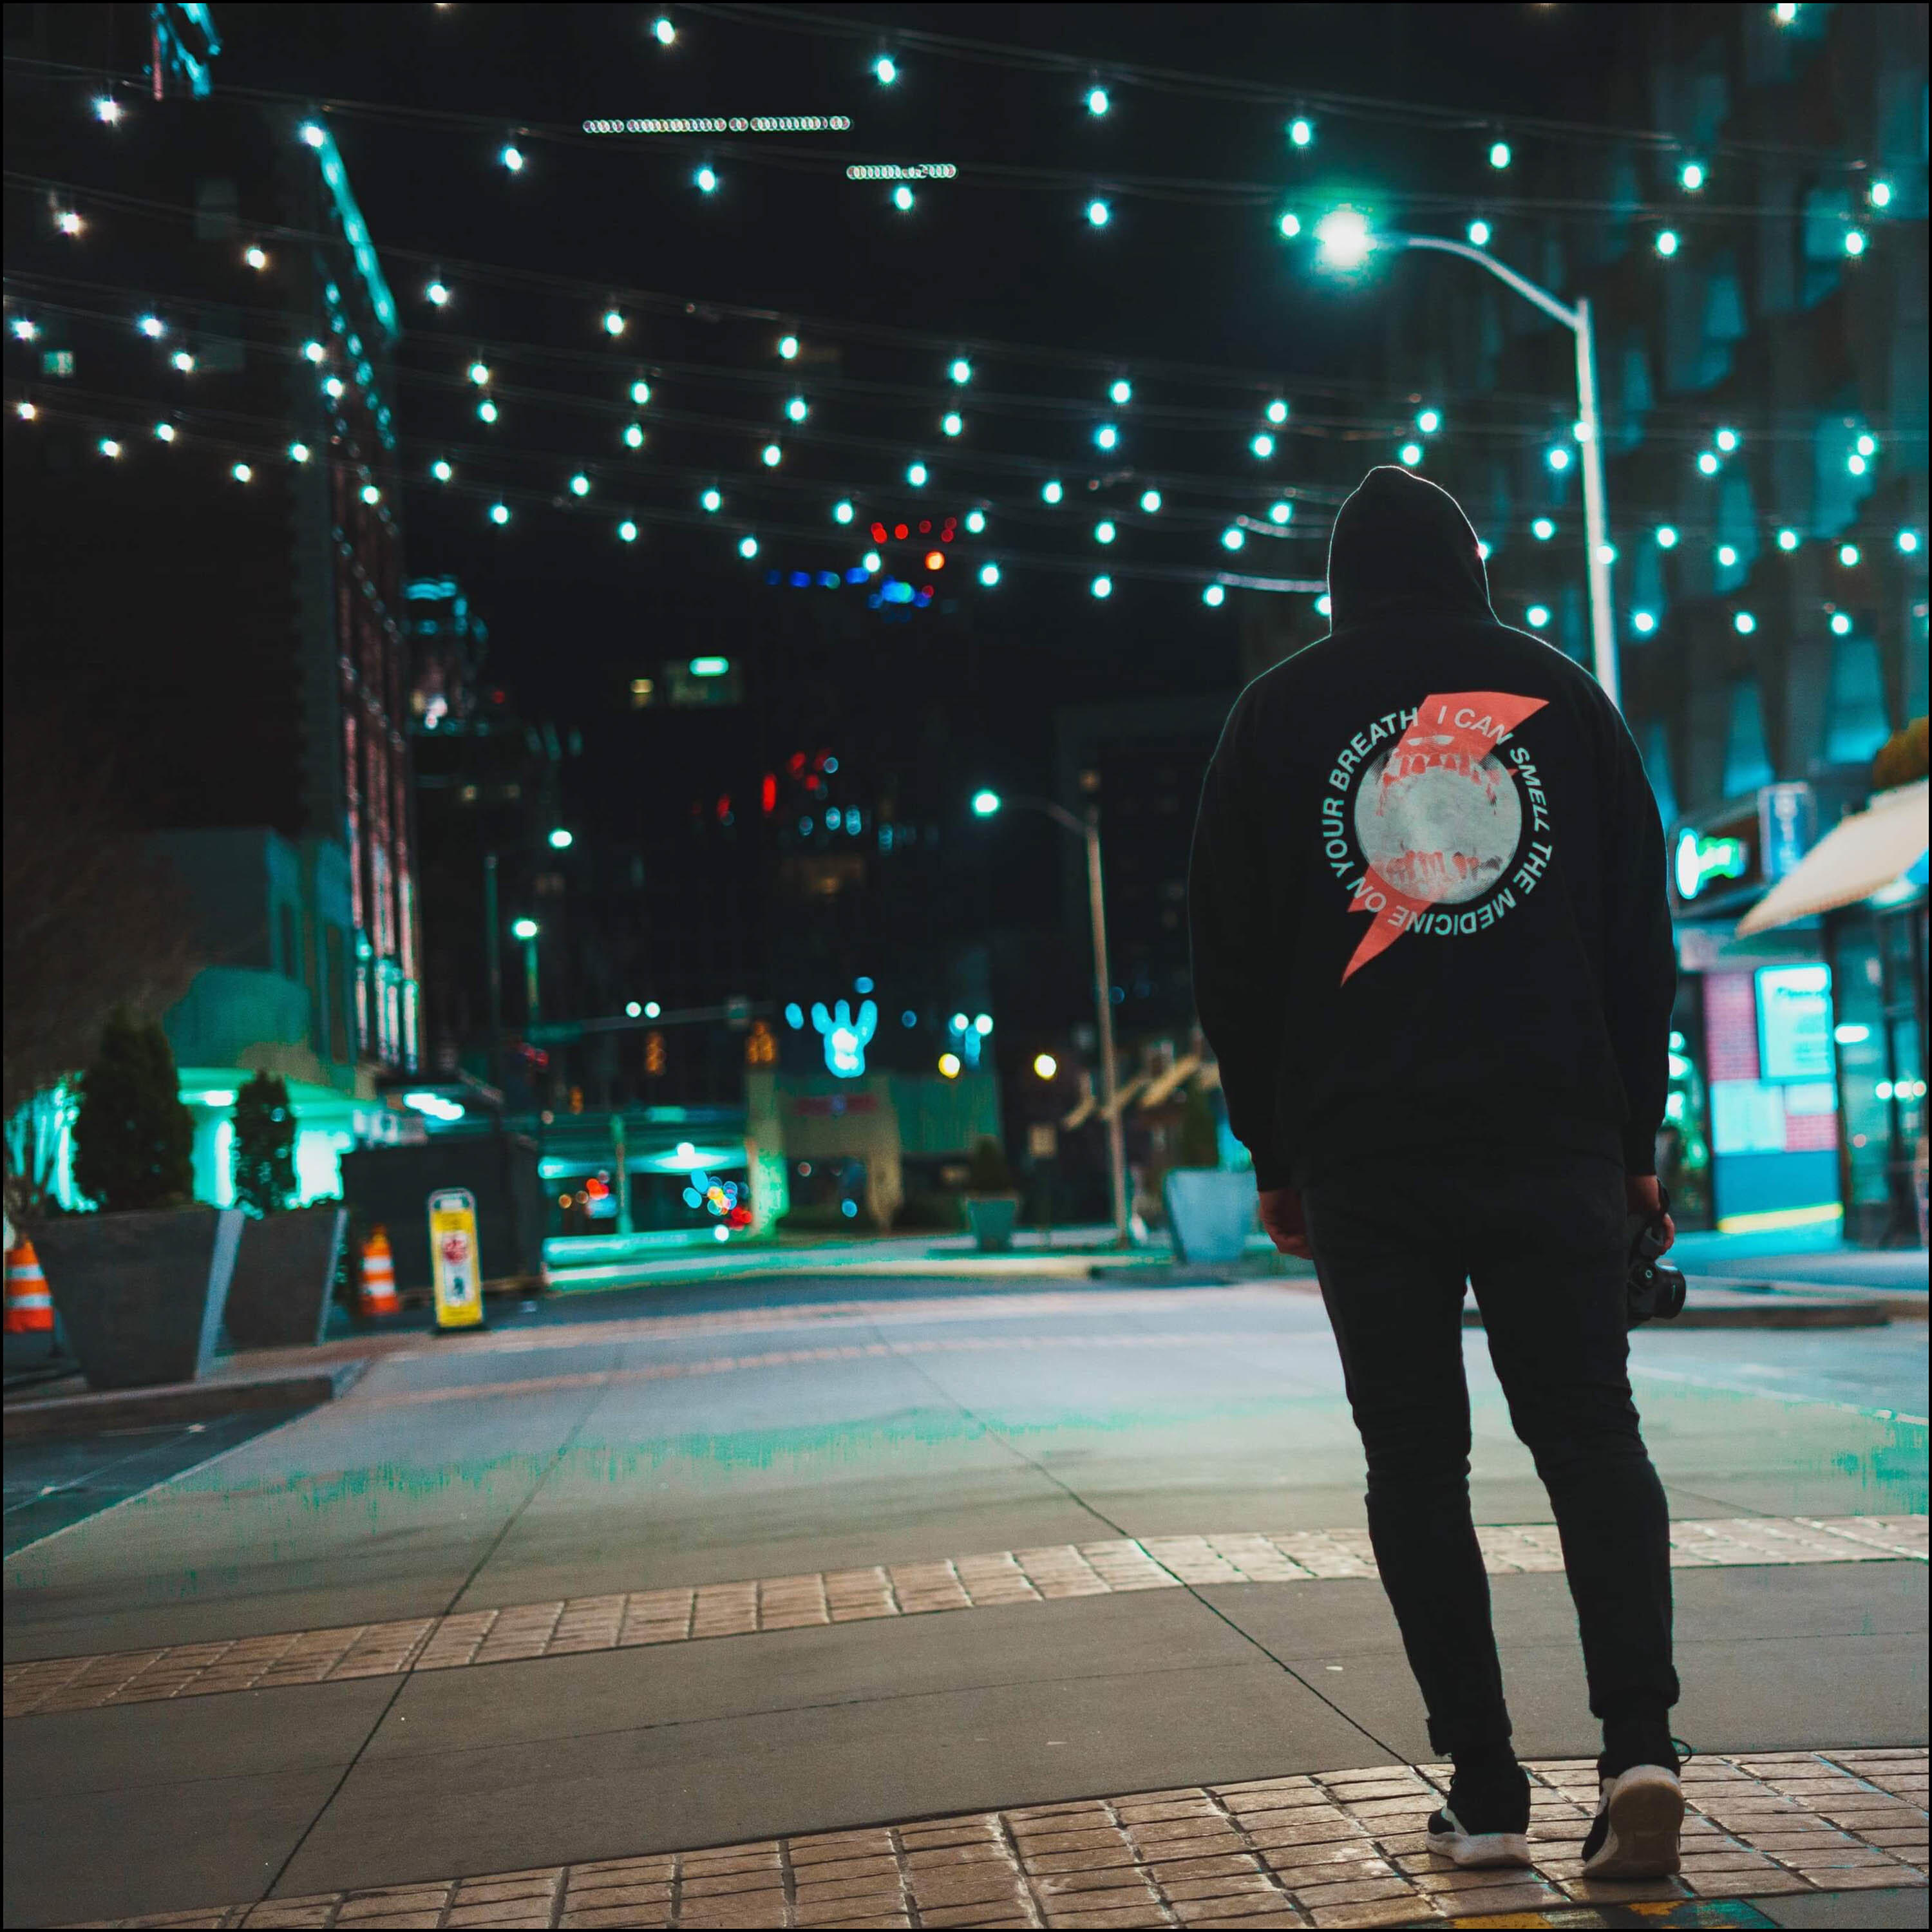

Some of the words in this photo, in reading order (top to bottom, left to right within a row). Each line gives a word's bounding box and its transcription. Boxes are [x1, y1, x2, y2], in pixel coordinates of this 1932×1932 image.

[1437, 706, 1447, 724] I
[1454, 708, 1513, 745] CAN
[1329, 707, 1418, 791] BREATH
[1510, 747, 1550, 832] SMELL
[1321, 797, 1355, 878] YOUR
[1513, 841, 1553, 895] THE
[1346, 875, 1387, 913] ON
[1388, 887, 1517, 936] MEDICINE
